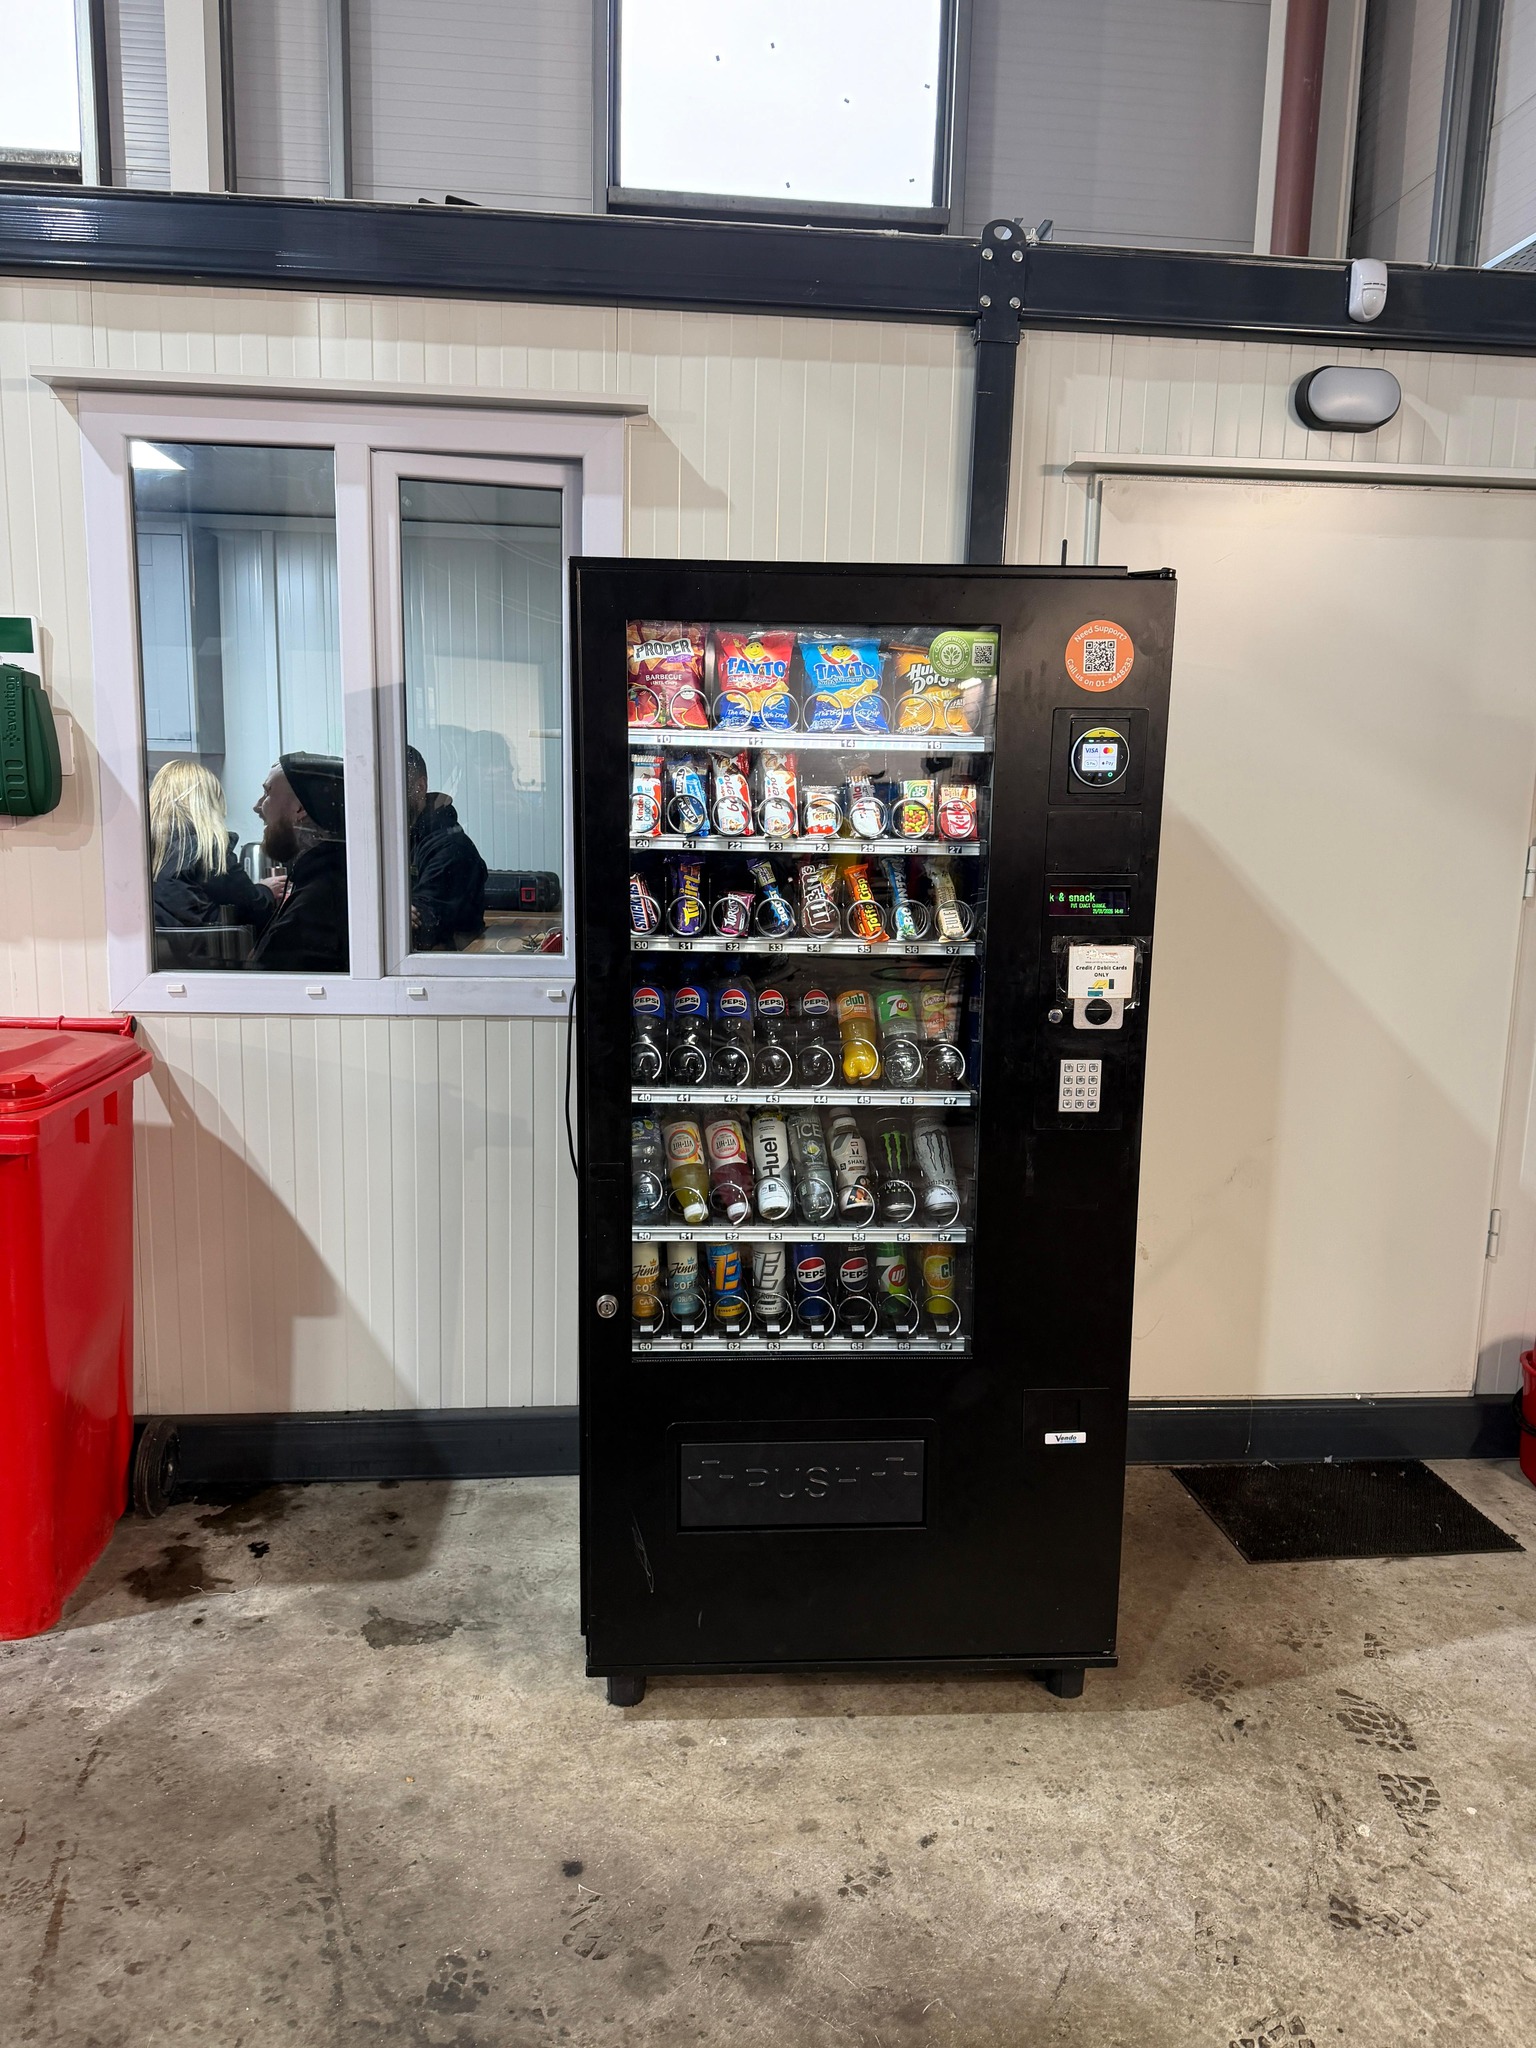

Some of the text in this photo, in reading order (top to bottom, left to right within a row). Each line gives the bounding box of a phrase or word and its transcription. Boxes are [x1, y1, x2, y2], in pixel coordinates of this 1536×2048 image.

[1074, 625, 1128, 643] Need Support?
[635, 639, 692, 659] PROPER
[727, 657, 787, 678] TAYTO
[814, 661, 876, 681] TAYTO
[1067, 657, 1133, 687] Call us on 01-4448233
[645, 673, 683, 681] BARBECUE
[5, 675, 16, 732] evolution
[657, 735, 671, 744] 10
[749, 737, 763, 746] 12
[841, 739, 855, 748] 14
[928, 741, 942, 750] 16
[636, 796, 644, 821] kinder
[685, 809, 698, 823] EAT
[858, 878, 872, 900] Crisp
[1058, 892, 1065, 902] &
[1068, 892, 1096, 902] snack
[680, 875, 701, 926] Twirl
[769, 890, 788, 922] BOOST
[675, 997, 699, 1005] PEPSI
[845, 993, 865, 1007] club
[796, 1123, 822, 1139] ICE
[760, 1137, 781, 1178] Huel
[1055, 1434, 1077, 1442] Vendo
[746, 1466, 861, 1499] PUSH
